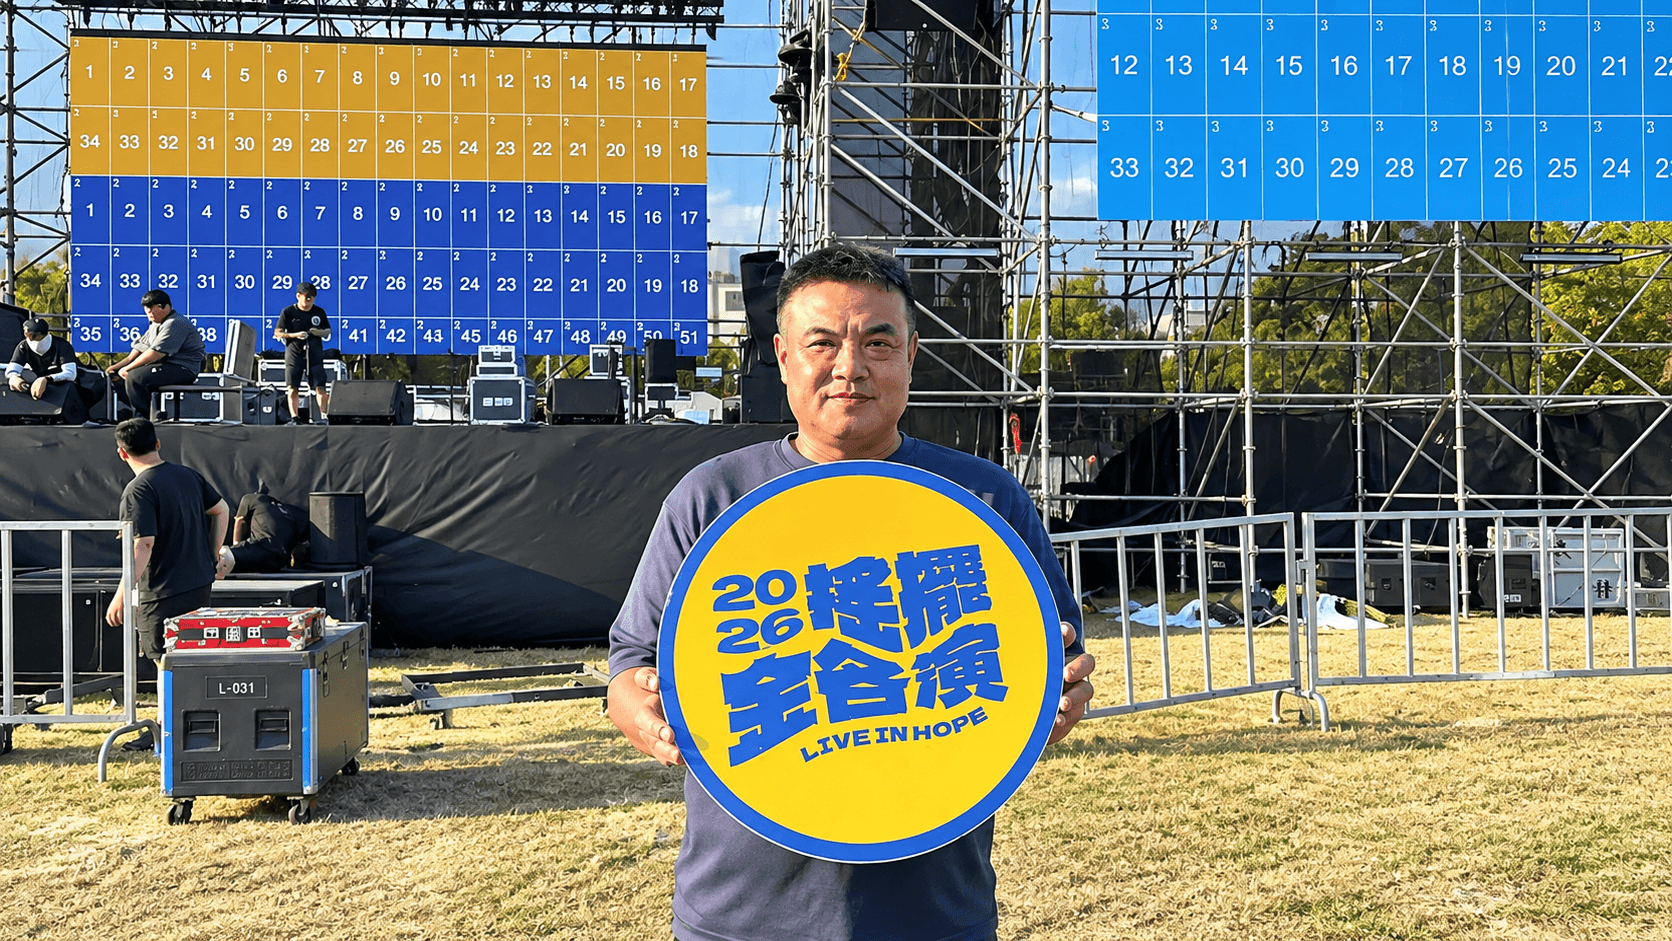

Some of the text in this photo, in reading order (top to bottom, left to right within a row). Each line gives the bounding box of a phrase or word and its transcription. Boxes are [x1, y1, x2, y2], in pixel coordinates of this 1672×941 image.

[1111, 55, 1672, 76] 12 13 14 15 16 17 18 19 20 21 2
[86, 65, 697, 91] 1 2 3 4 5 6 7 8 9 10 11 12 13 14 15 16 17
[80, 134, 698, 158] 34 33 32 31 30 29 28 27 26 25 24 23 22 21 20 19 18
[1110, 158, 1672, 178] 33 32 31 30 29 28 27 26 25 24 2
[87, 203, 698, 224] 1 2 3 4 5 6 7 8 9 10 11 12 13 14 15 16 17
[80, 274, 698, 292] 34 33 32 31 30 29 28 27 26 25 24 23 22 21 20 19 18
[80, 327, 102, 341] 35
[119, 327, 141, 341] 36
[349, 329, 366, 342] 41
[386, 329, 405, 342] 42
[461, 329, 481, 343] 45
[497, 329, 518, 343] 46
[533, 329, 554, 343] 47
[570, 329, 591, 344] 48
[607, 330, 627, 343] 49
[680, 330, 697, 344] 51
[712, 569, 797, 612] 20
[716, 608, 804, 654] 26
[219, 682, 255, 694] L-031
[800, 706, 989, 763] LIVE IN HOPE
